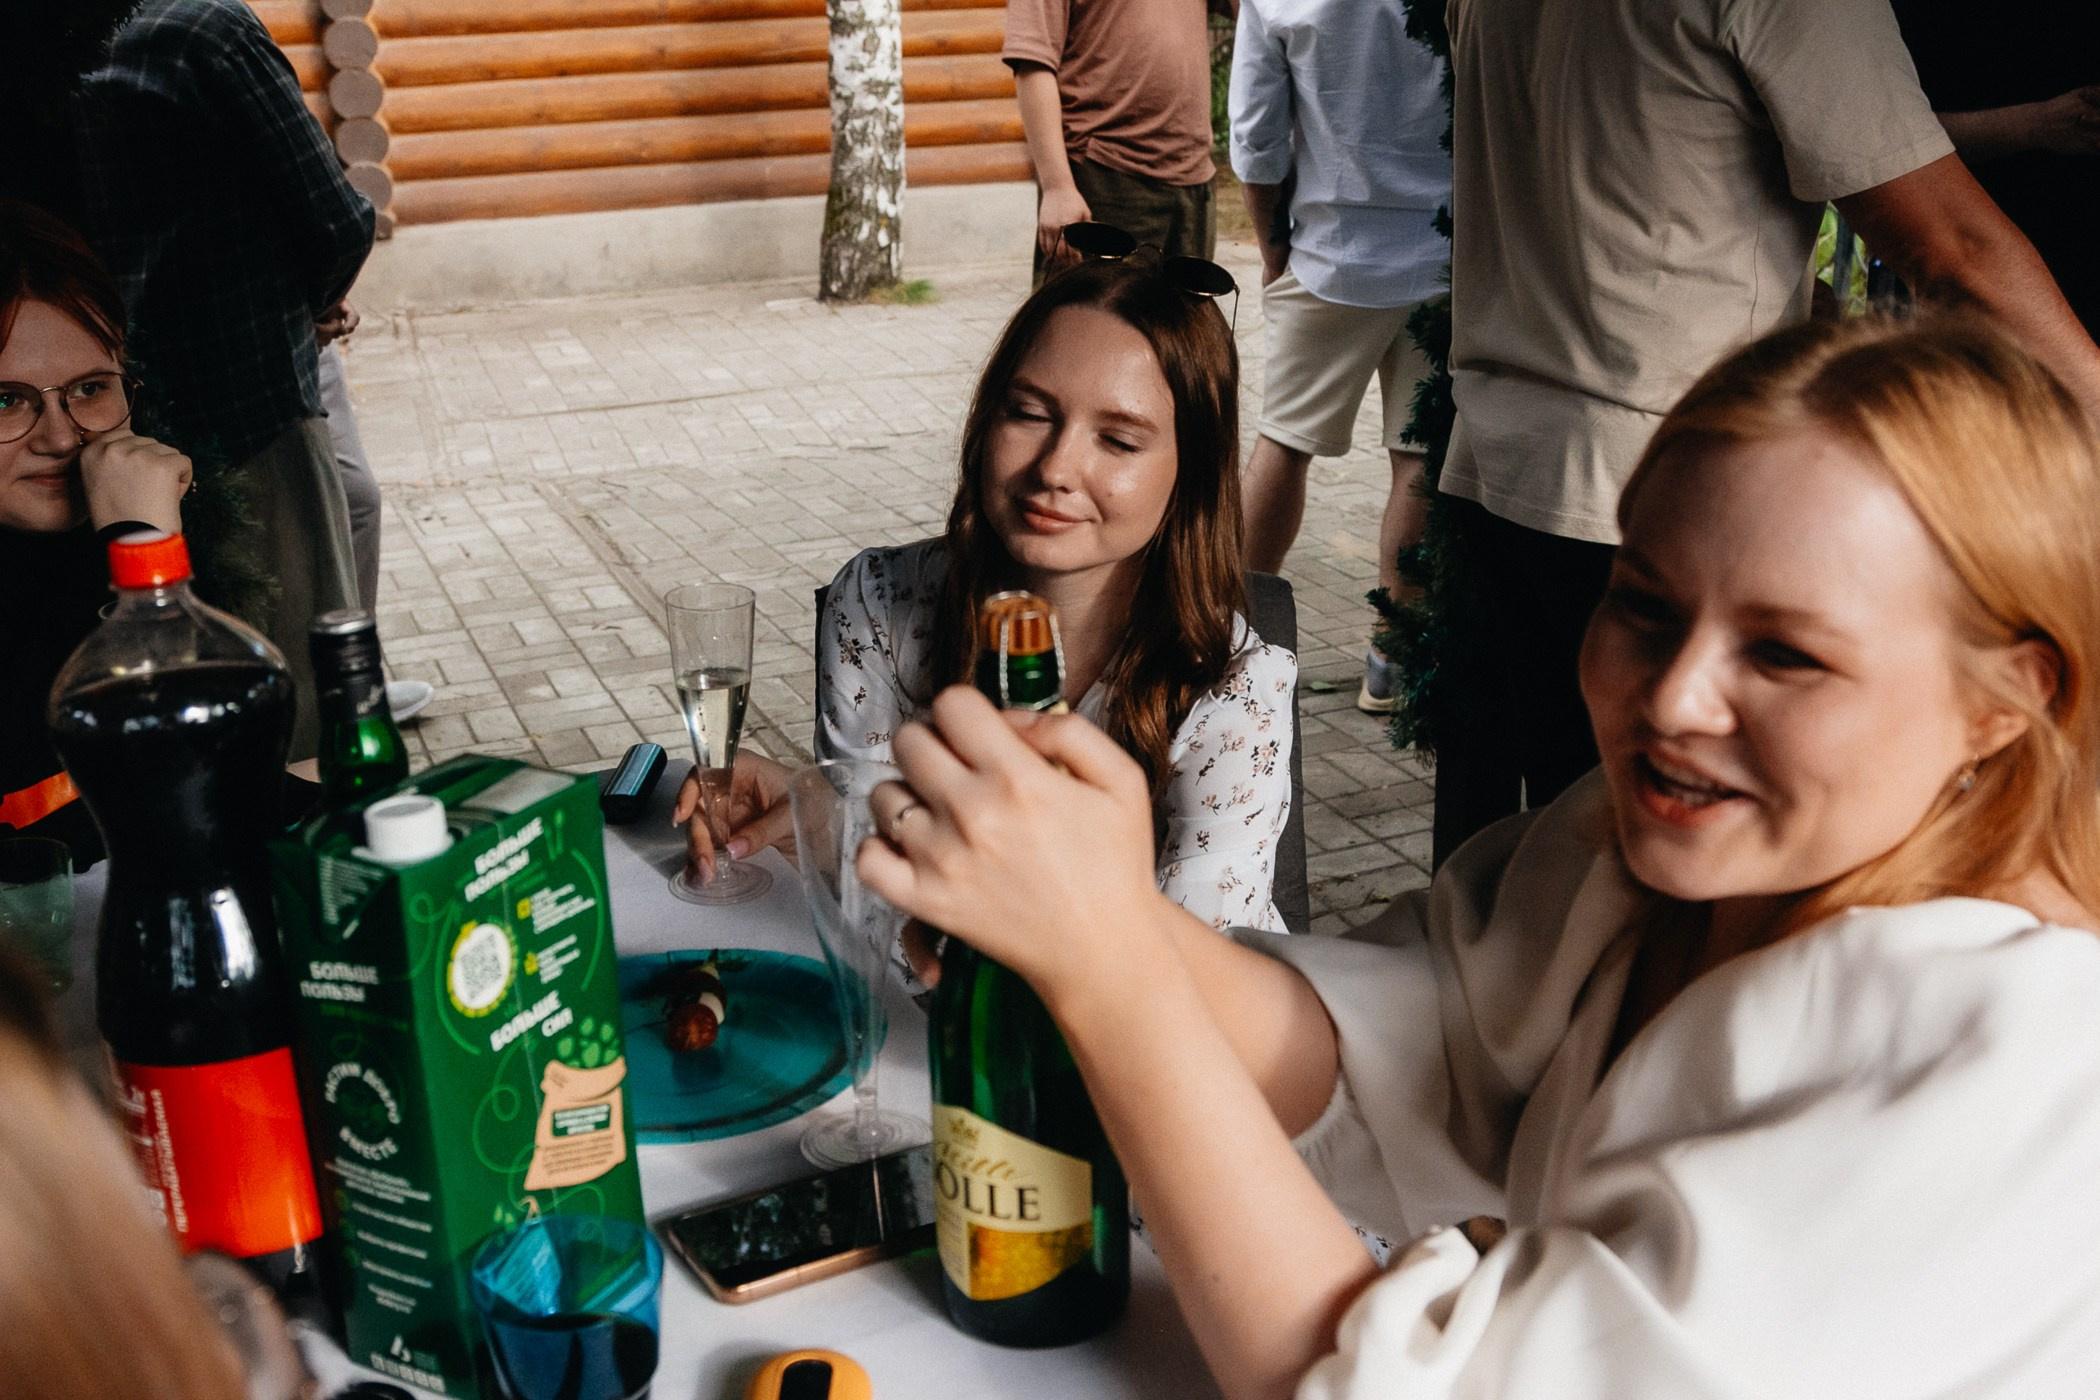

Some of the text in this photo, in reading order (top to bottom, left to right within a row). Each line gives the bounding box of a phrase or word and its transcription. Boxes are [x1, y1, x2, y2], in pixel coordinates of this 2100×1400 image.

[474, 816, 544, 875] БОЛЬШЕ
[464, 848, 530, 902] ПОЛЬЗЫ
[300, 981, 366, 1003] ПОЛЬЗЫ
[309, 961, 379, 985] БОЛЬШЕ
[489, 989, 562, 1052] БОЛЬШЕ
[541, 1007, 573, 1038] СИЛ
